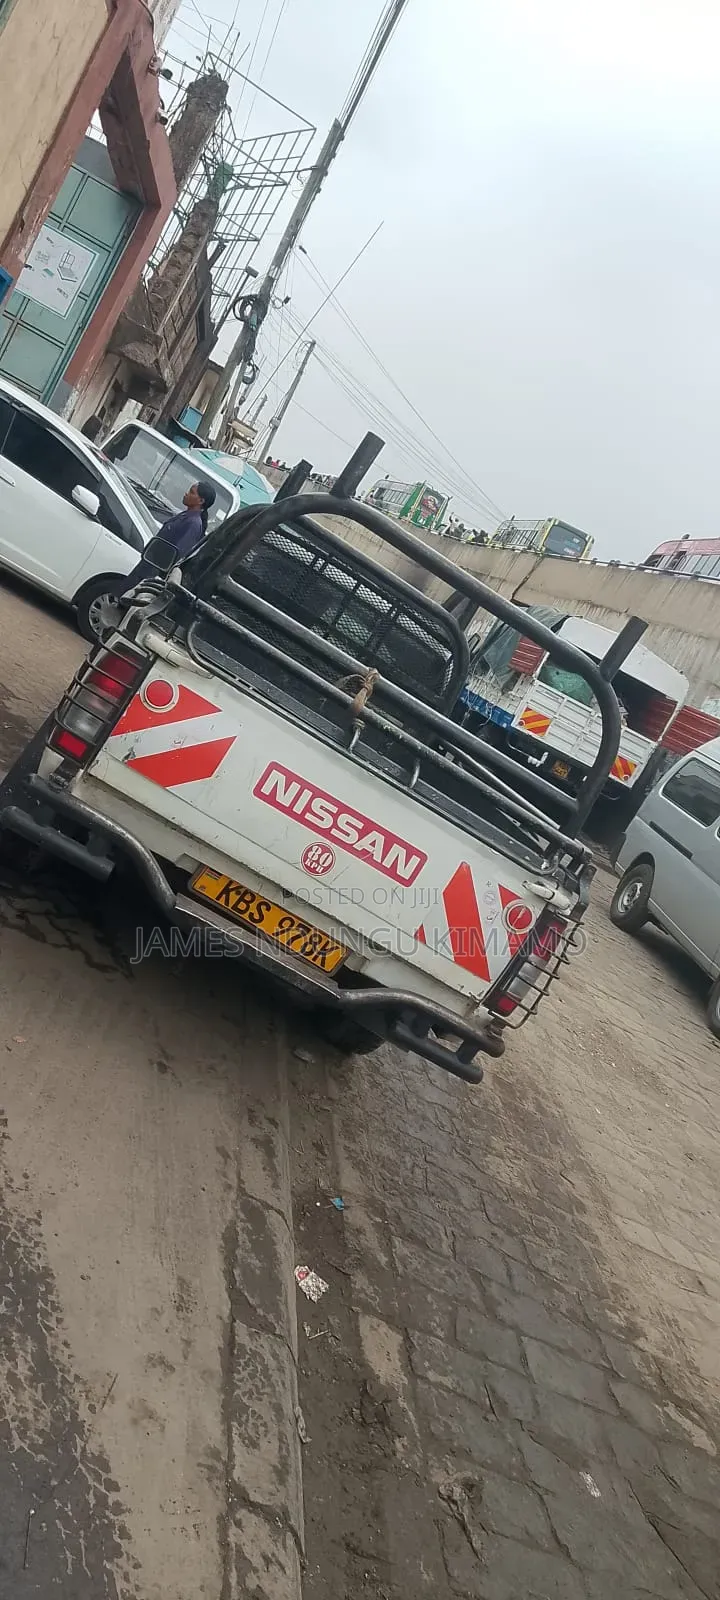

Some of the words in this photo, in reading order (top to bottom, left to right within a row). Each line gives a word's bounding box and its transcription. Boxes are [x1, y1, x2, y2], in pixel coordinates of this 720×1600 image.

[260, 769, 421, 880] NISSAN
[304, 858, 324, 874] KPH
[308, 845, 333, 868] 80
[216, 878, 272, 925] KBS
[272, 916, 339, 968] 978K
